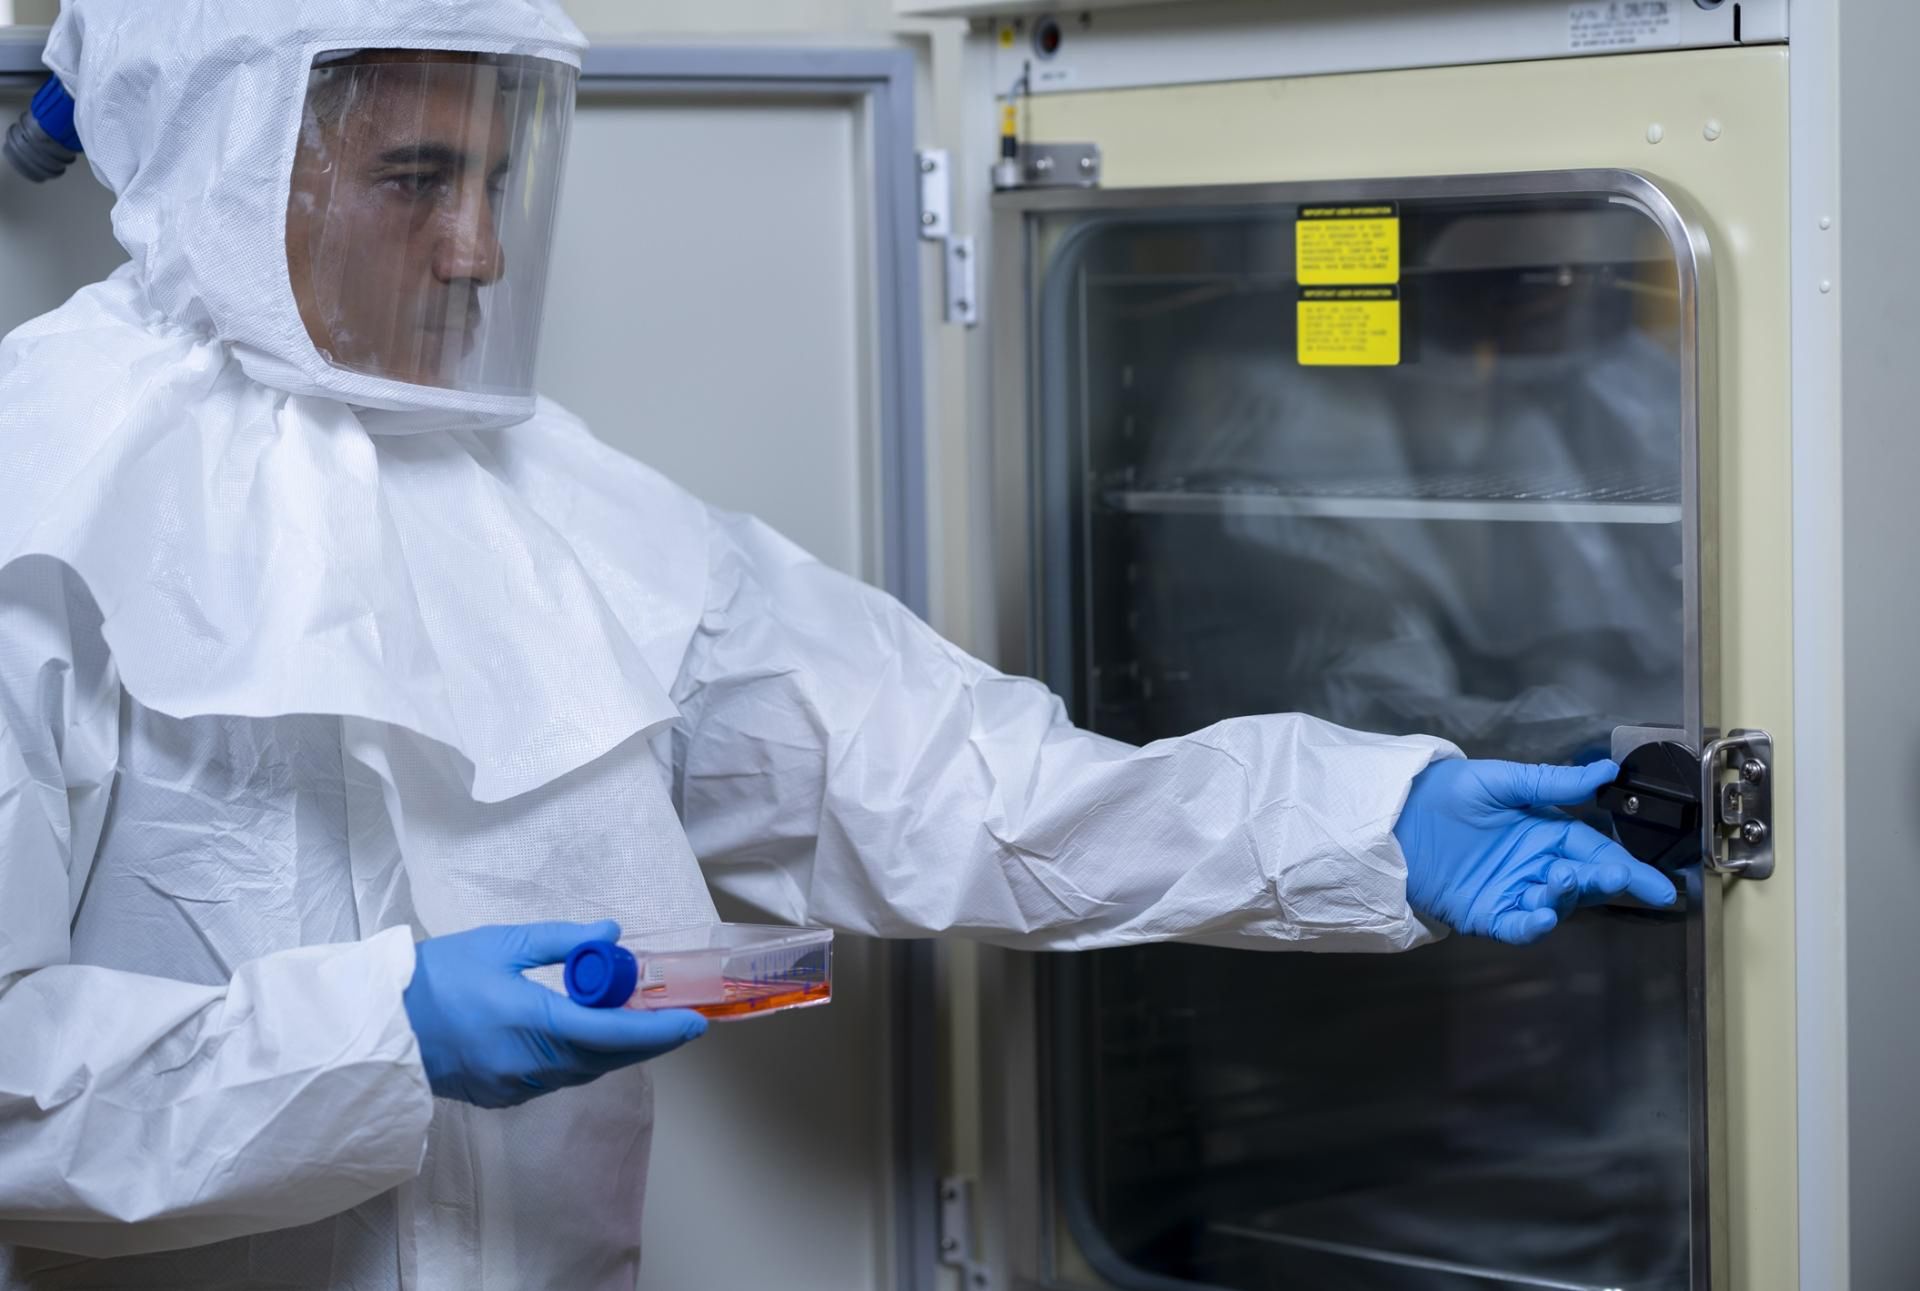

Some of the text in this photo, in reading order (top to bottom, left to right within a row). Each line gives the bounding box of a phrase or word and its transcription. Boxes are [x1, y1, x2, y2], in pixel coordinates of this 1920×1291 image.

[1624, 2, 1668, 18] CAUTION
[1303, 207, 1392, 217] IMPORTANT USER INFORMATION
[1304, 290, 1336, 298] IMPORTANT
[1353, 289, 1392, 297] INFORMATION
